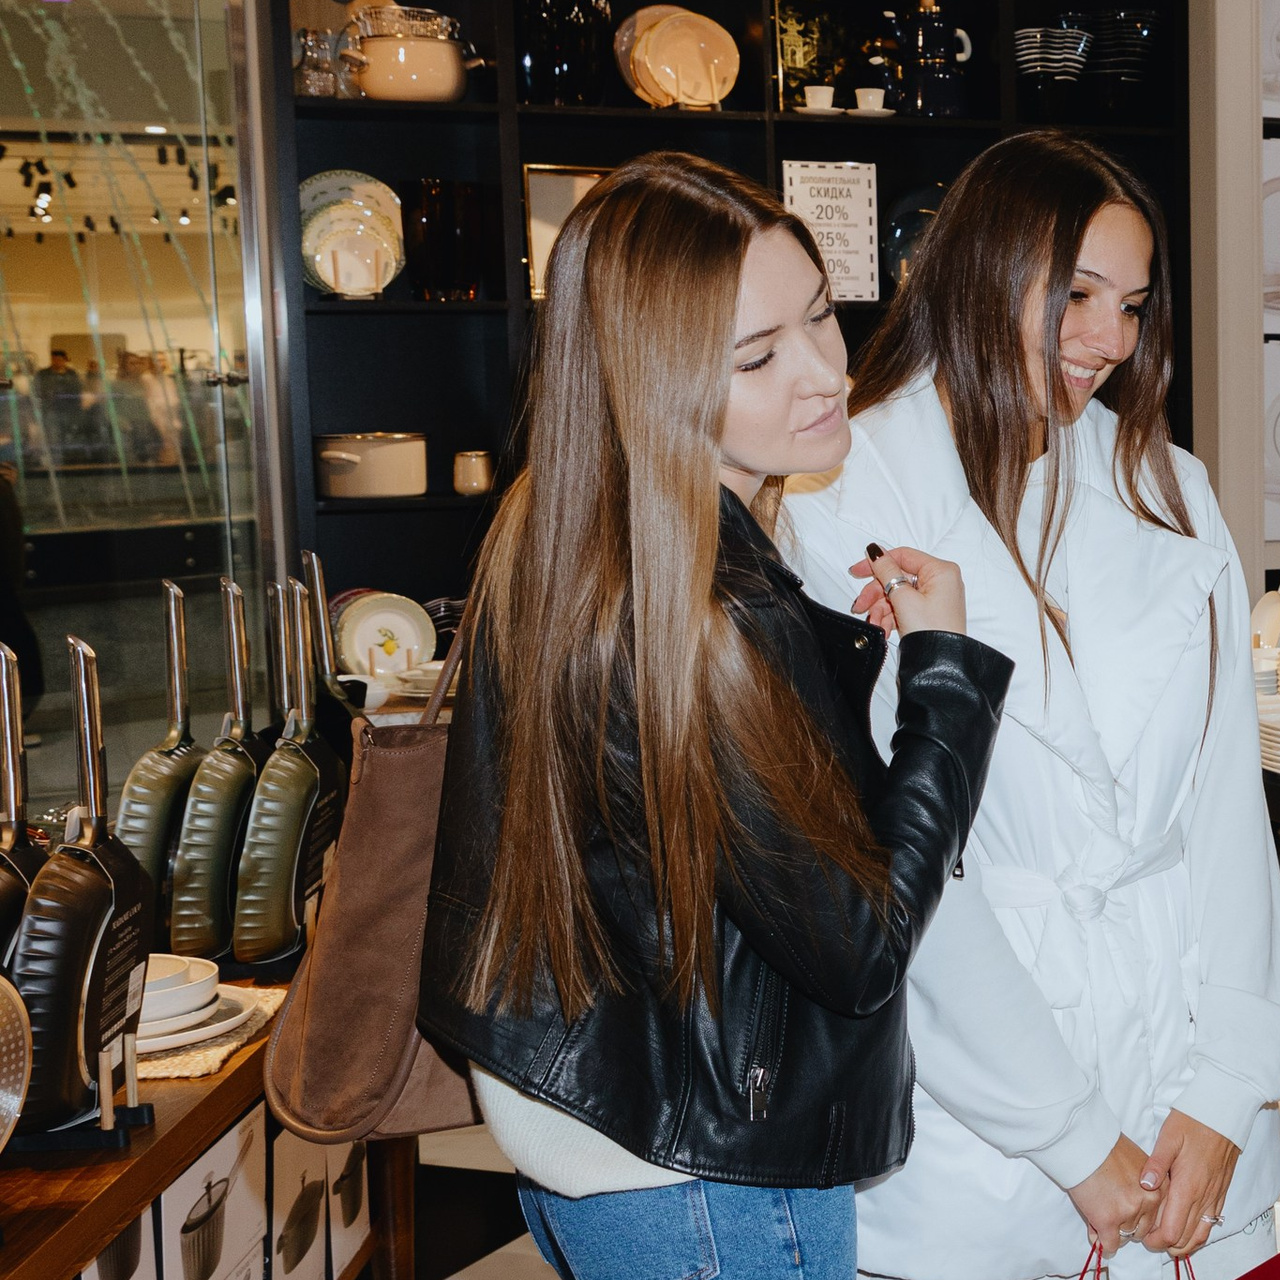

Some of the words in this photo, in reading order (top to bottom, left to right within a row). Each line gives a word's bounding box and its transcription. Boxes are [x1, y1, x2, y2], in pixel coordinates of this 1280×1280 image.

[809, 186, 852, 200] СКИДКА
[810, 204, 849, 221] -20%
[816, 231, 850, 247] 25%
[826, 258, 851, 275] 0%
